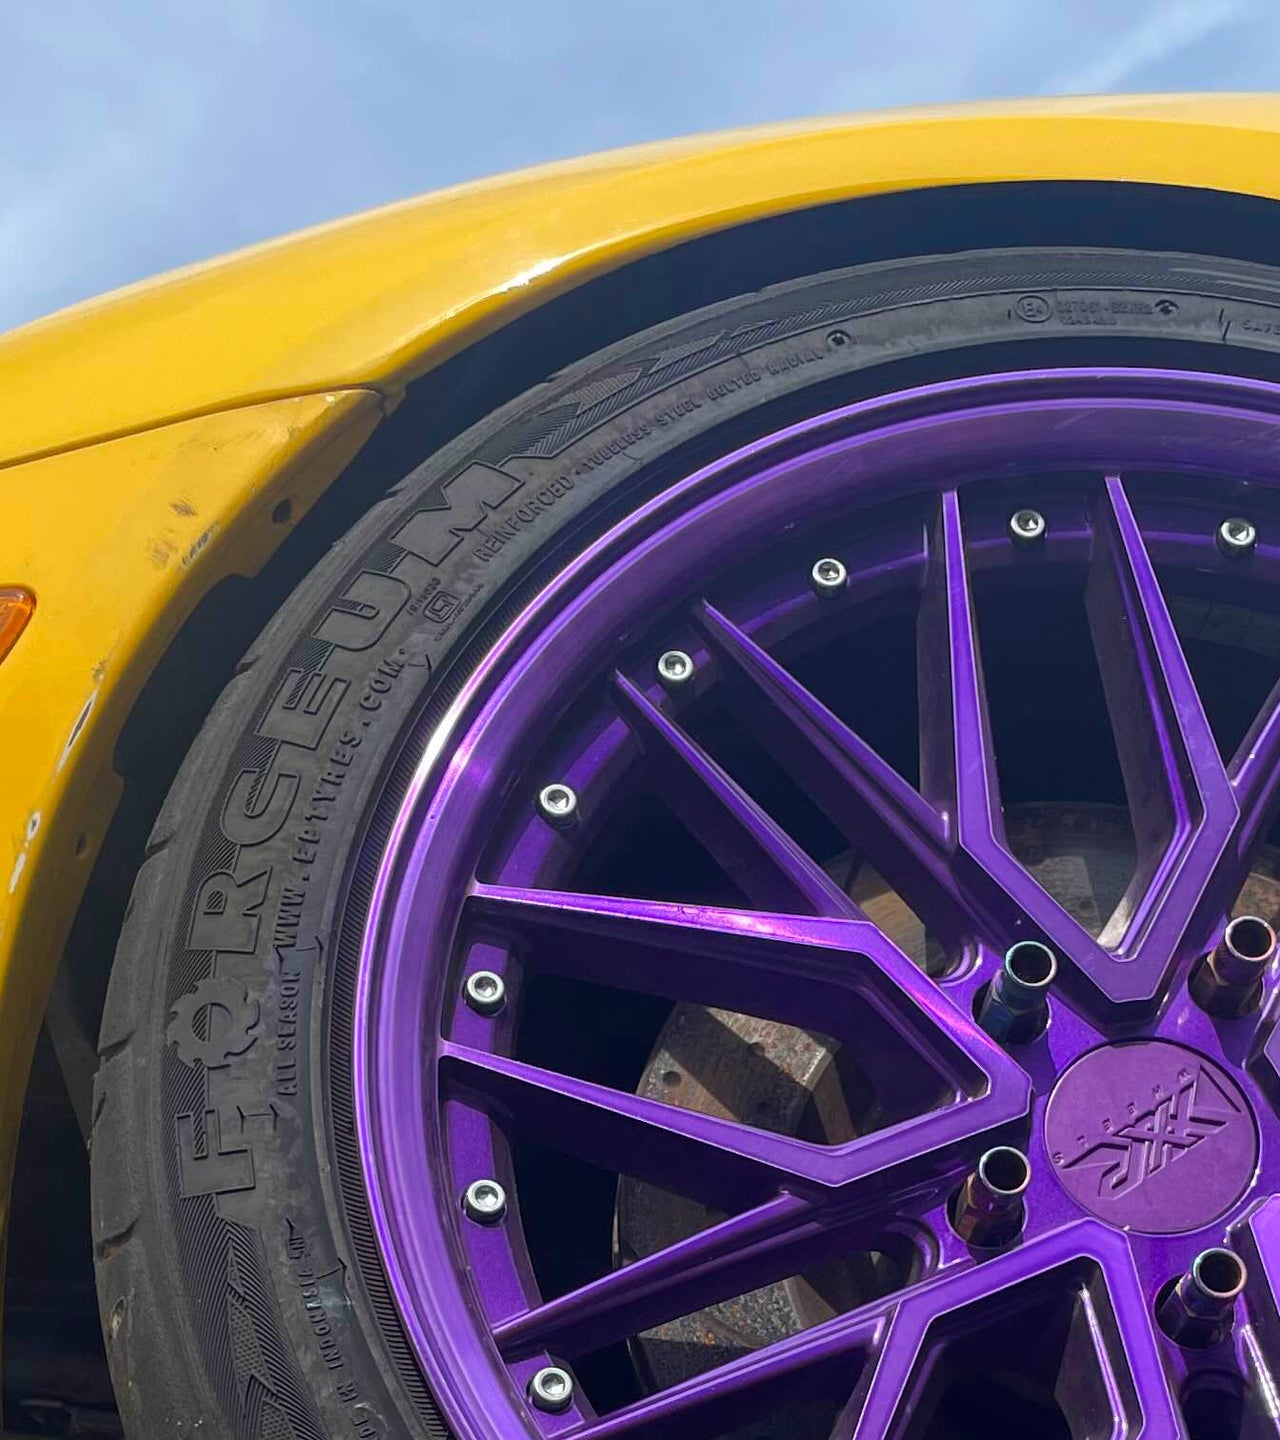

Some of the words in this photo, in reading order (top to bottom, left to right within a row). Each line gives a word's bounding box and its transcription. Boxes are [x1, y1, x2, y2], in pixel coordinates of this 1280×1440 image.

[470, 470, 577, 565] REINFORCED
[580, 421, 653, 474] TUBELESS
[653, 395, 703, 429] STEEL
[703, 367, 762, 404] BELTED
[277, 967, 303, 1052] SEASON
[275, 1056, 300, 1097] ALL
[295, 1268, 346, 1372] INDONESIA
[333, 1377, 360, 1404] IN
